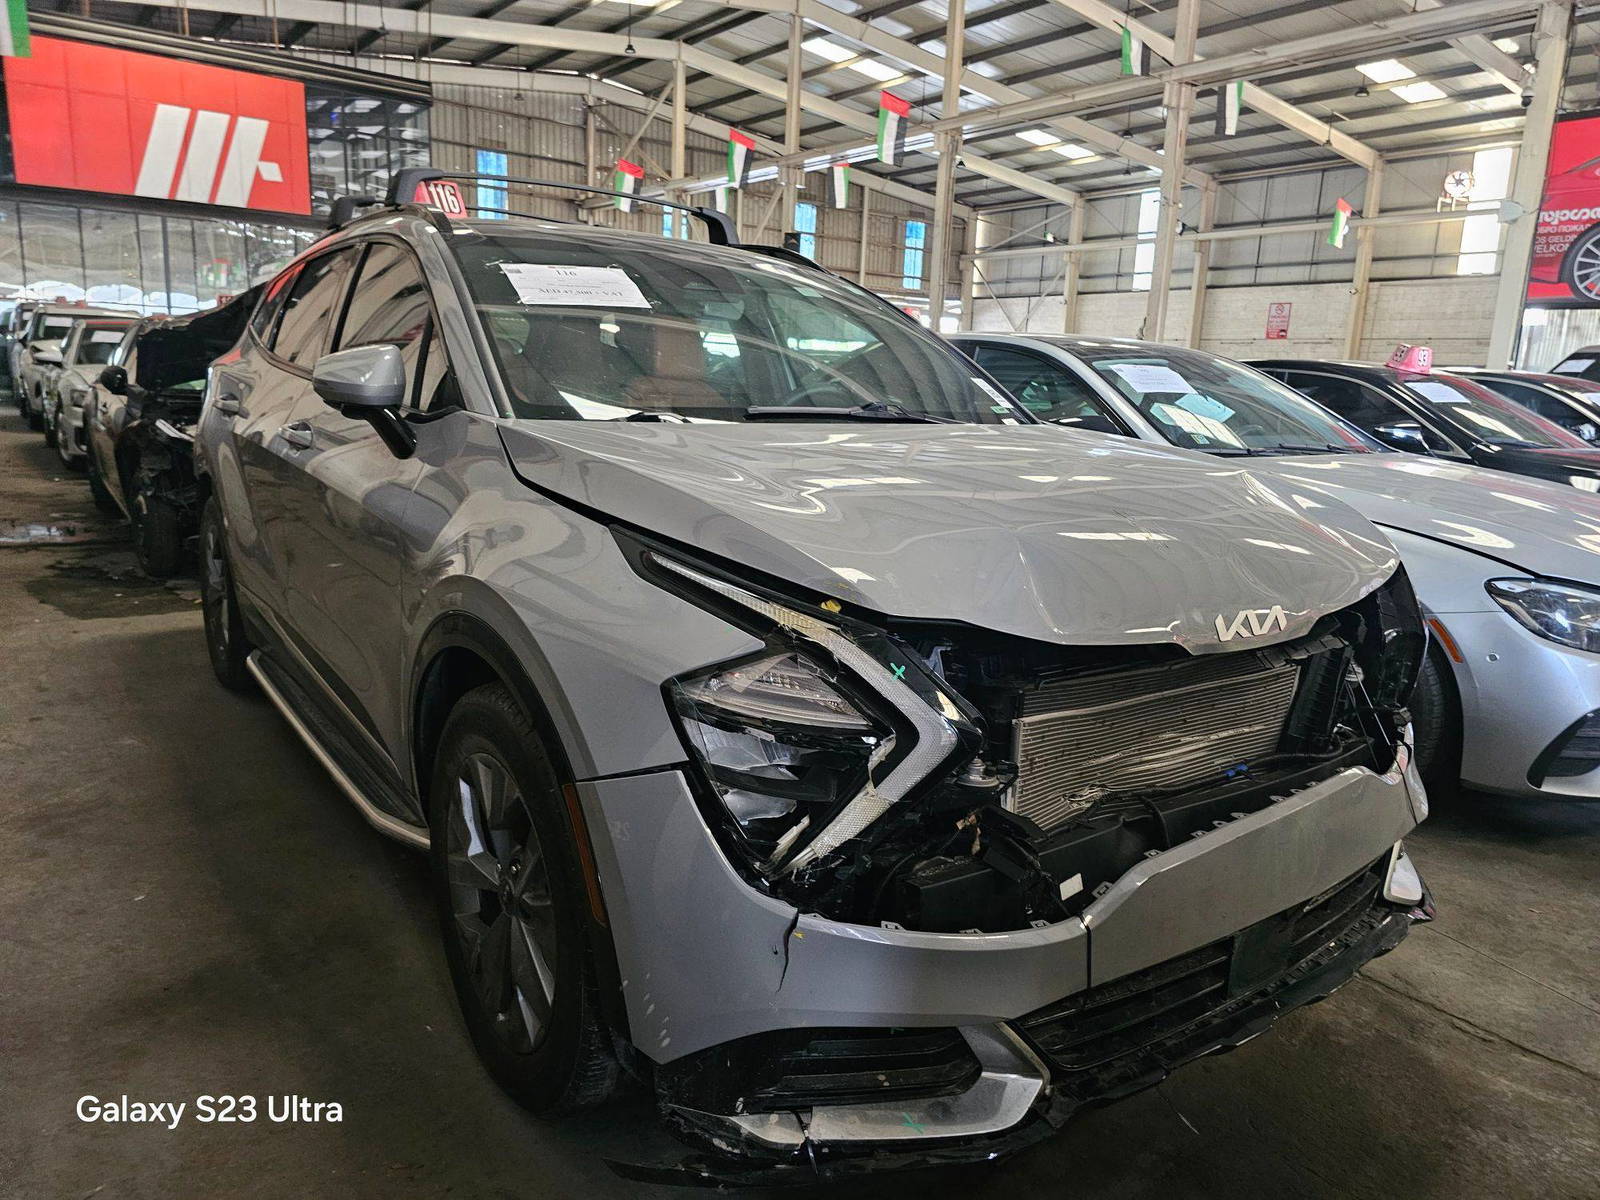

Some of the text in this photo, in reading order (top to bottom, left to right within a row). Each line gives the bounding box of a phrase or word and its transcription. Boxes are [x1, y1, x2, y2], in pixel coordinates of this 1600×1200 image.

[429, 183, 462, 214] 116
[1418, 350, 1429, 367] 93
[1214, 605, 1287, 642] KIA
